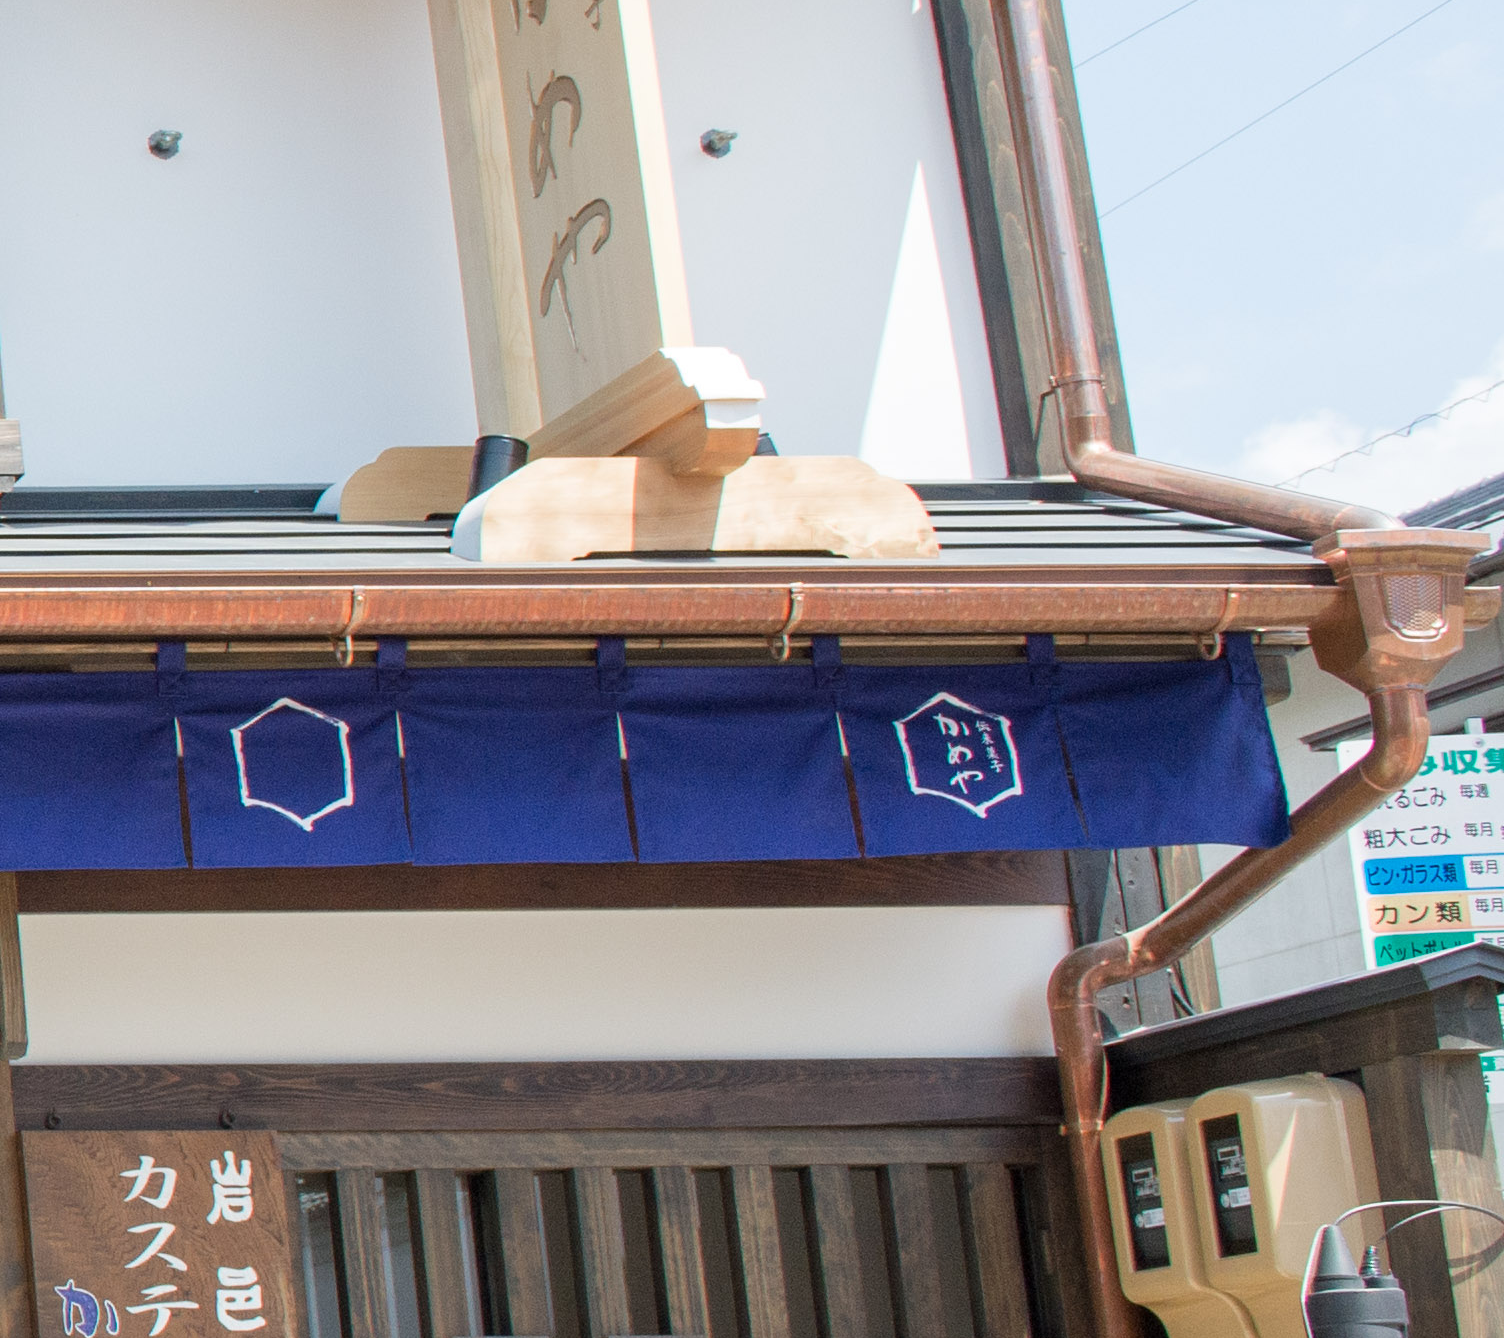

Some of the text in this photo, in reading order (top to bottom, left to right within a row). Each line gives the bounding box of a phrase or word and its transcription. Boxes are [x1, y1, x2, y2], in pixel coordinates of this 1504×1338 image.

[932, 713, 984, 794] かめや
[1460, 784, 1489, 798] 毎週
[1363, 826, 1450, 848] 粗大ごみ
[1464, 822, 1493, 836] 毎月
[1469, 860, 1498, 874] 毎月
[1375, 901, 1462, 925] カン類
[206, 1151, 267, 1331] 岩邑
